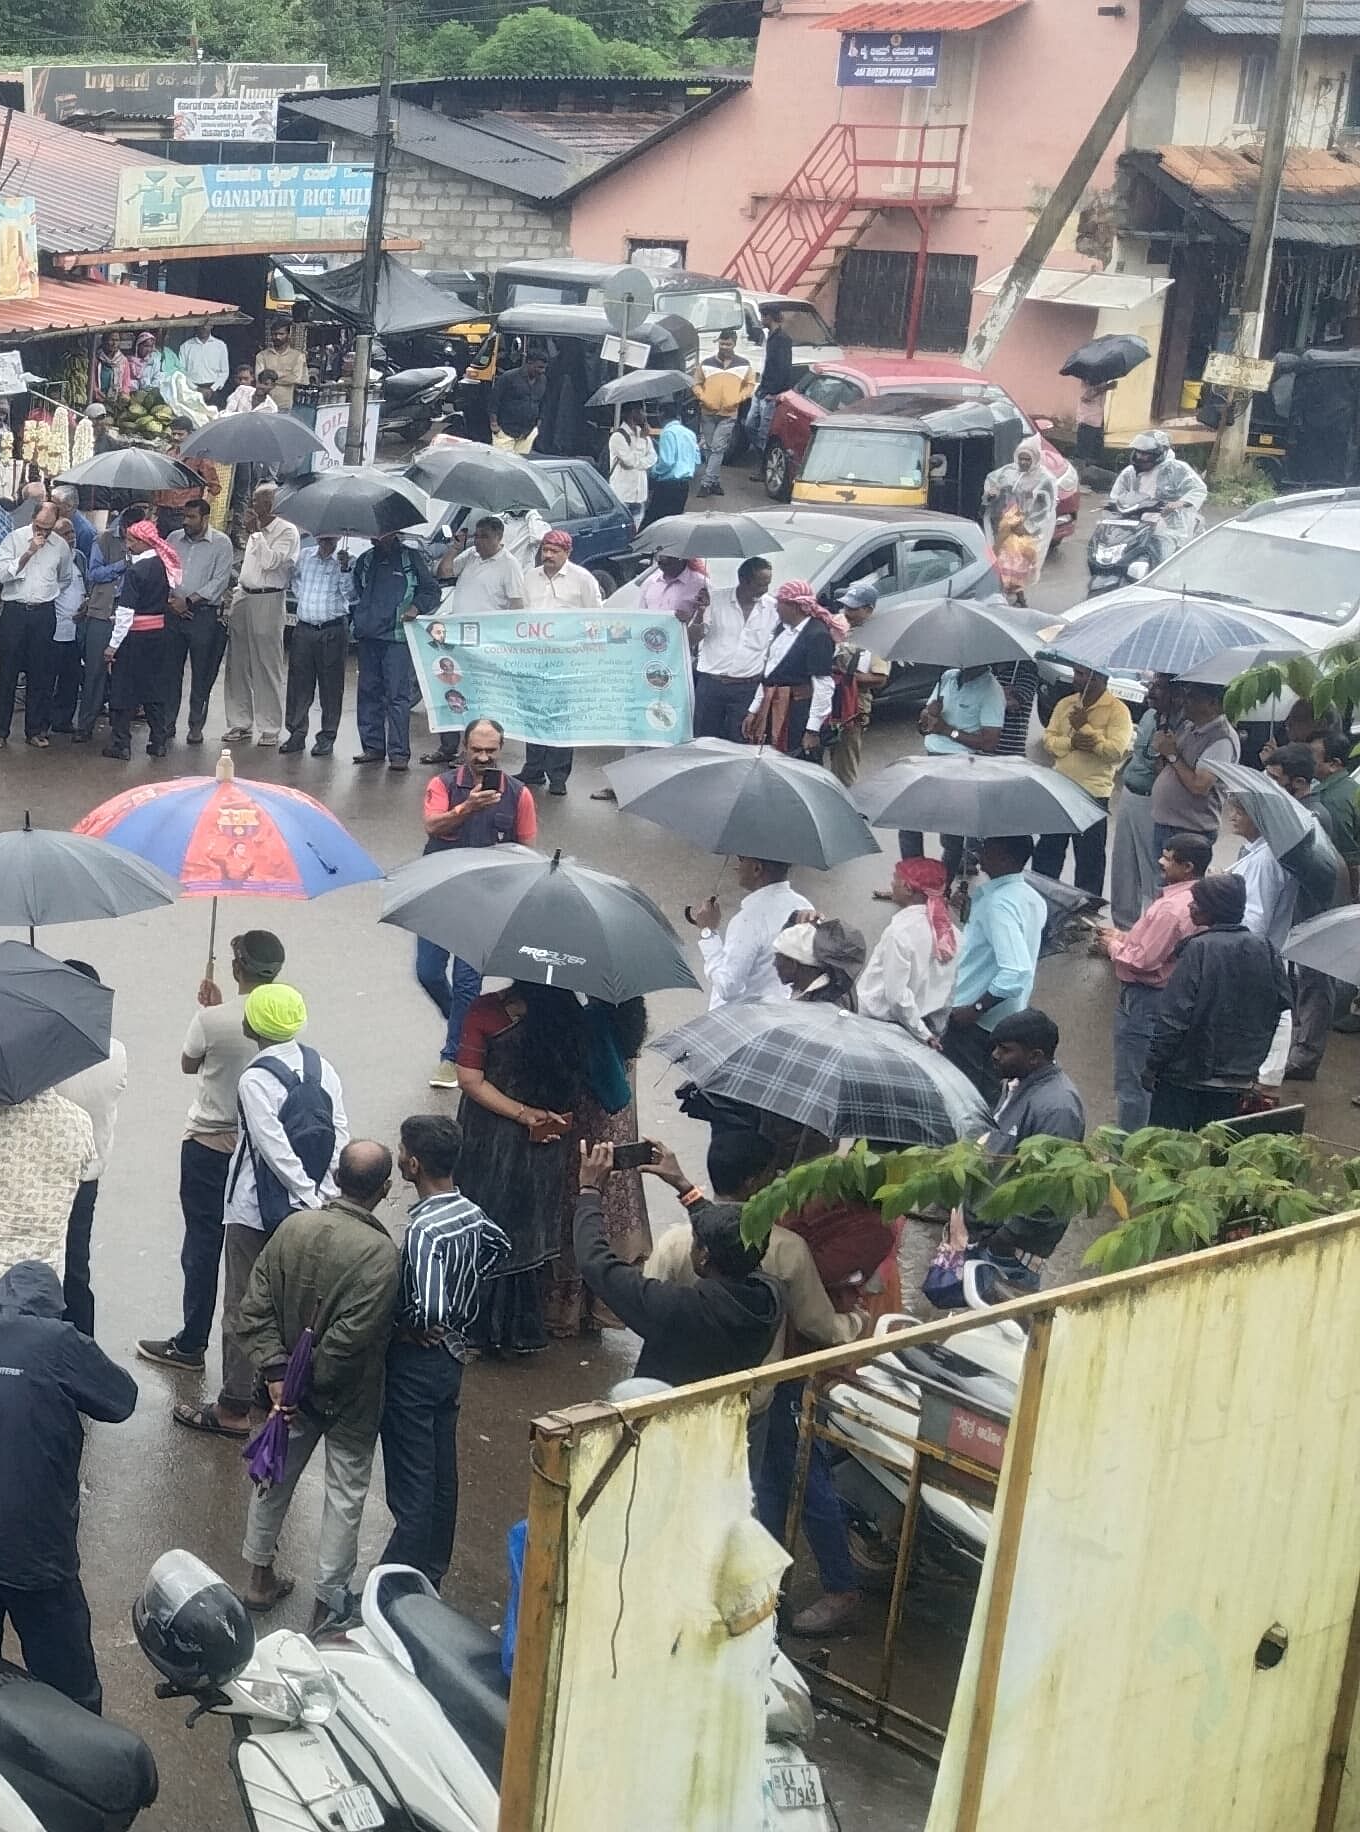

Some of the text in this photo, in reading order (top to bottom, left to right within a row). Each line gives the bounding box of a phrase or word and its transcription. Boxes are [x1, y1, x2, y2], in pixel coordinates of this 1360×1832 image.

[211, 188, 298, 208] GANAPATHY
[303, 187, 335, 206] RICE
[515, 621, 555, 640] CNC
